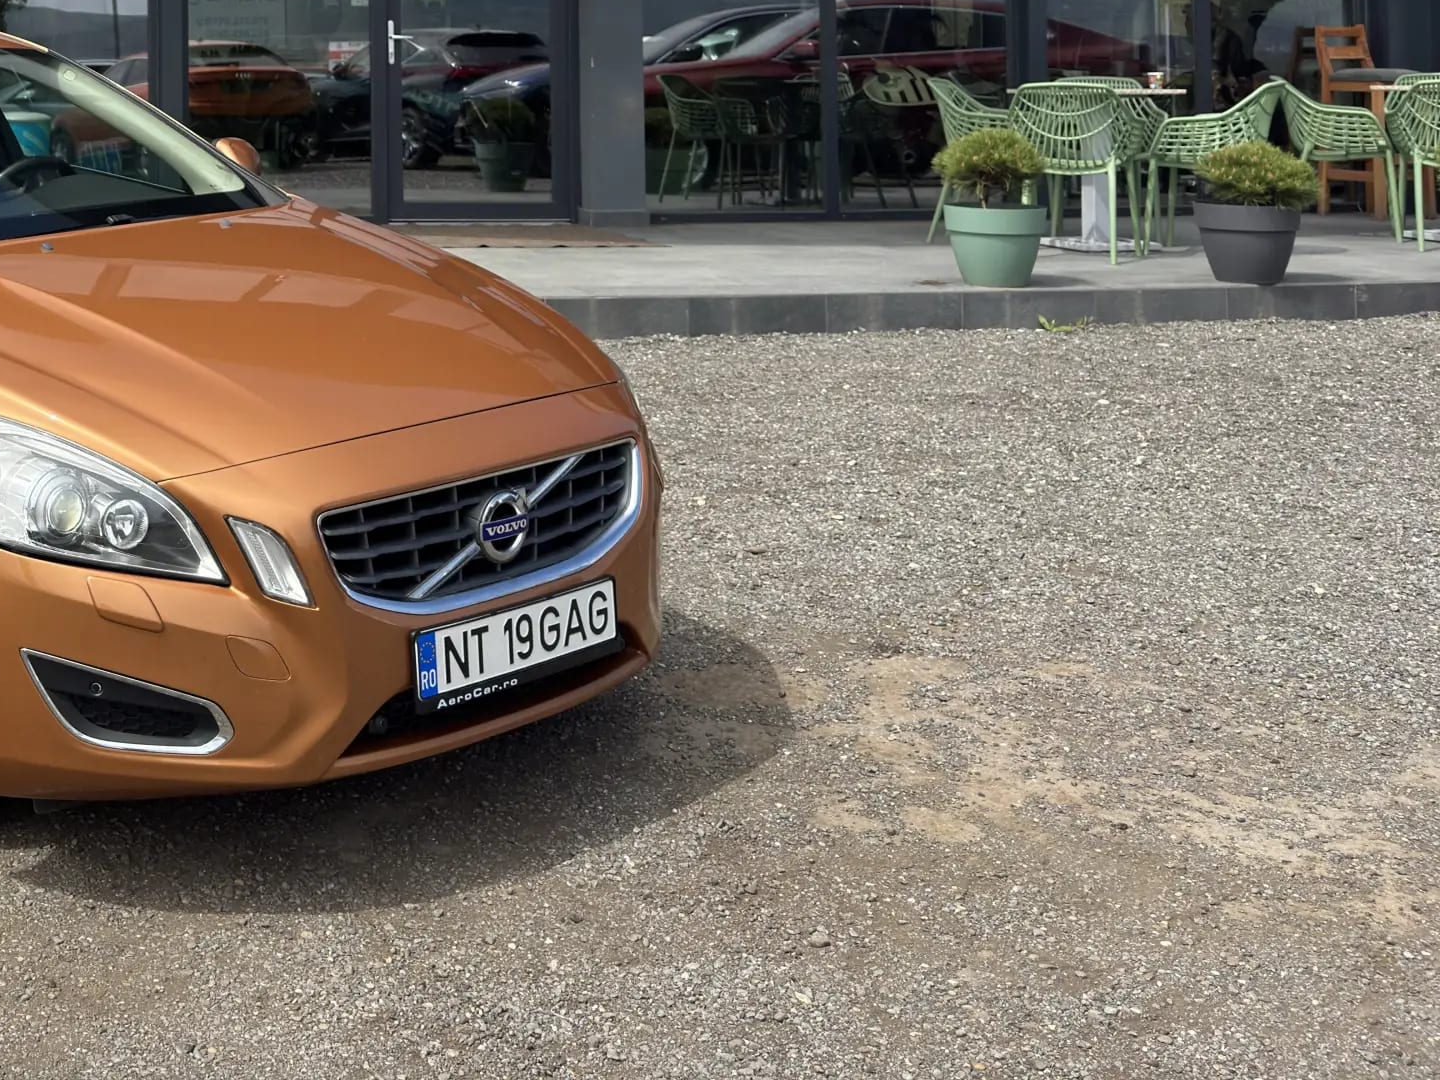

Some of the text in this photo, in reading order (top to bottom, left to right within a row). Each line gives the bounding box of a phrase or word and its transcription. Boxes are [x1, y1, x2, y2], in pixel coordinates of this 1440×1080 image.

[485, 518, 527, 536] VOLVO
[443, 625, 489, 685] NT
[420, 669, 437, 691] RO
[437, 678, 518, 709] AeroCar.ro
